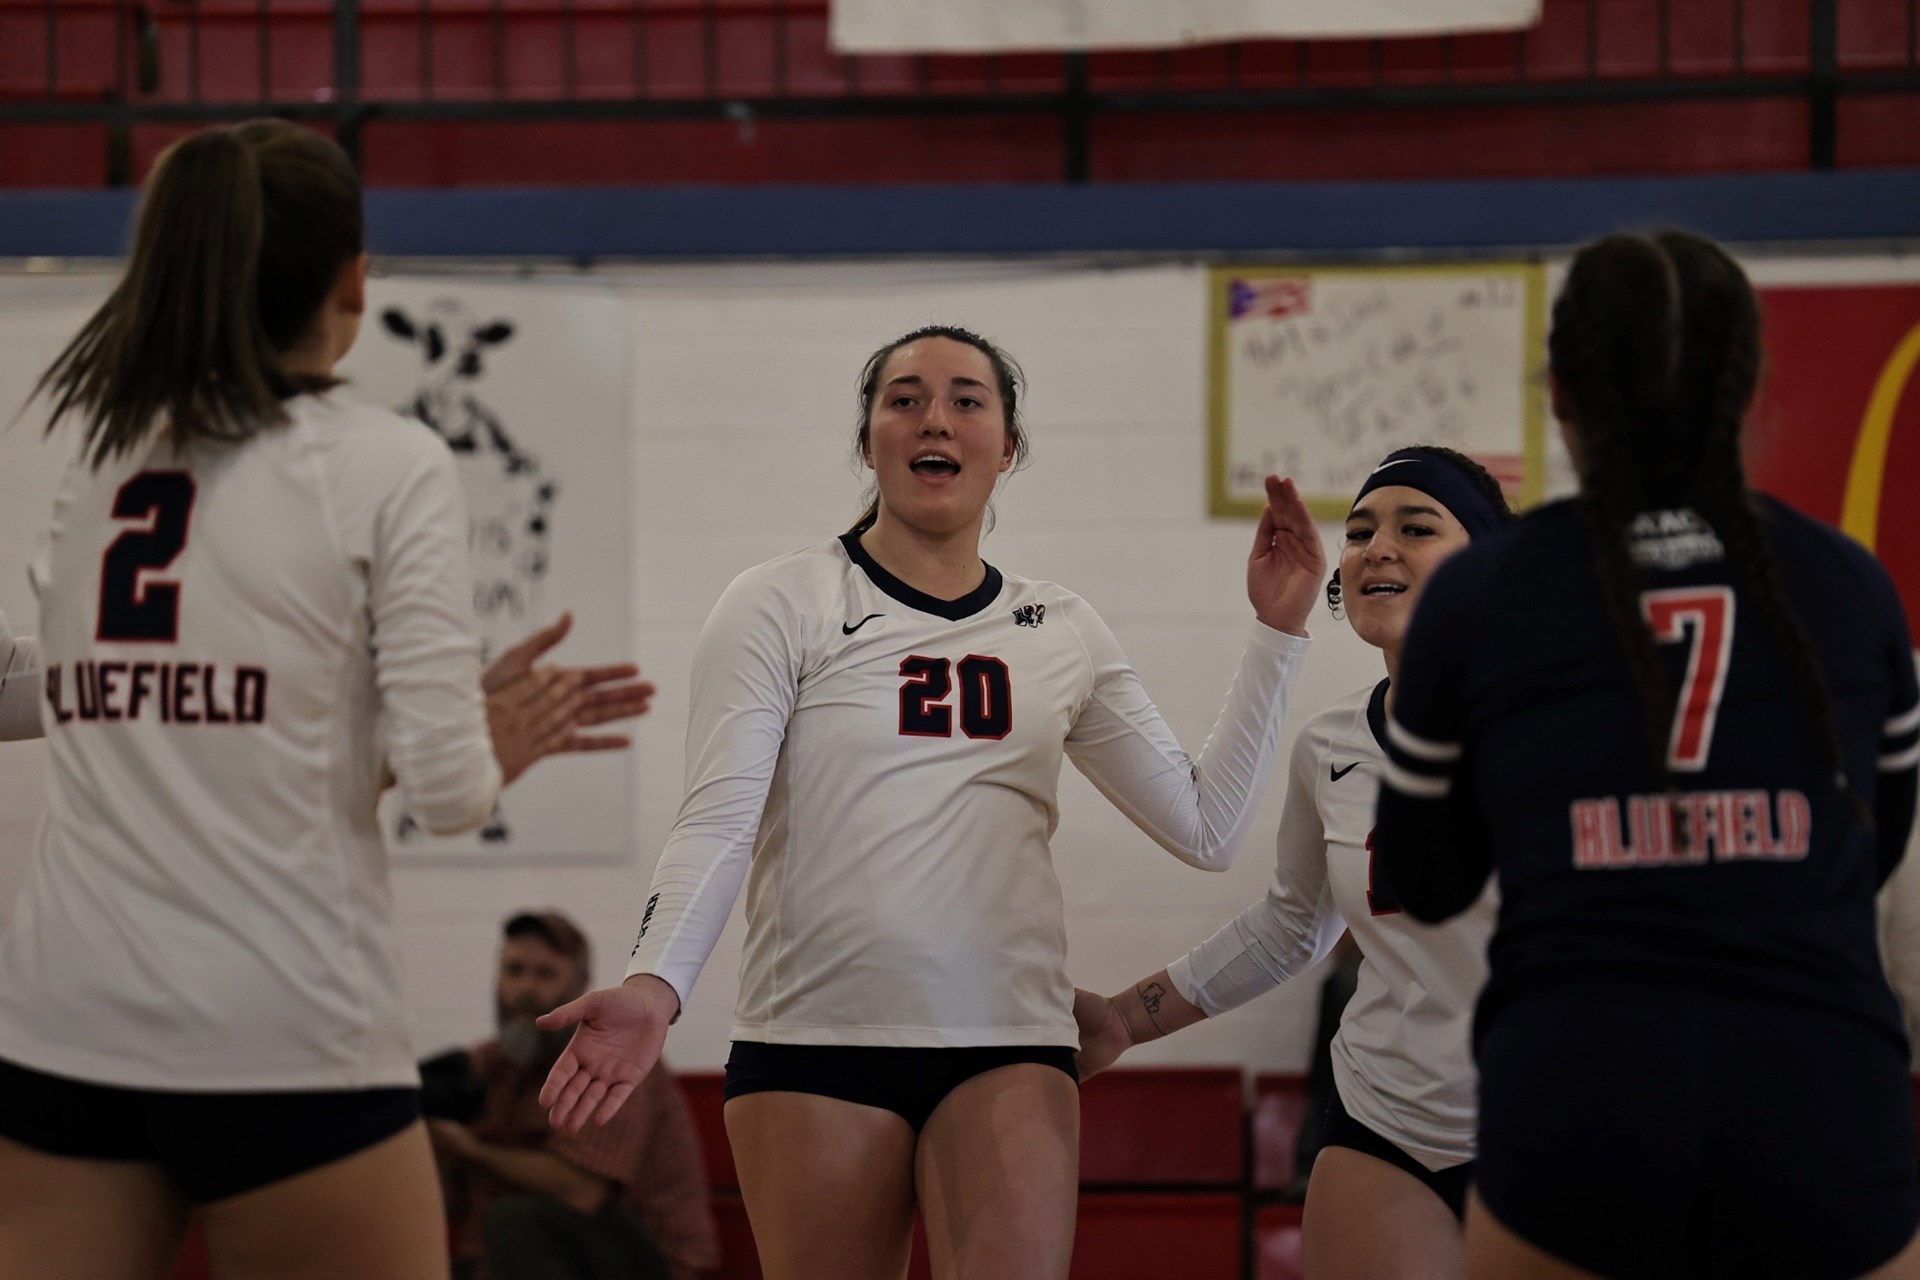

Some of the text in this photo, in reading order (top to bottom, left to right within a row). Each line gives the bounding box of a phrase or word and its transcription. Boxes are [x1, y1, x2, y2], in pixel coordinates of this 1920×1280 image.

[97, 469, 197, 643] 2
[898, 654, 1013, 741] 20
[1640, 586, 1735, 771] 7
